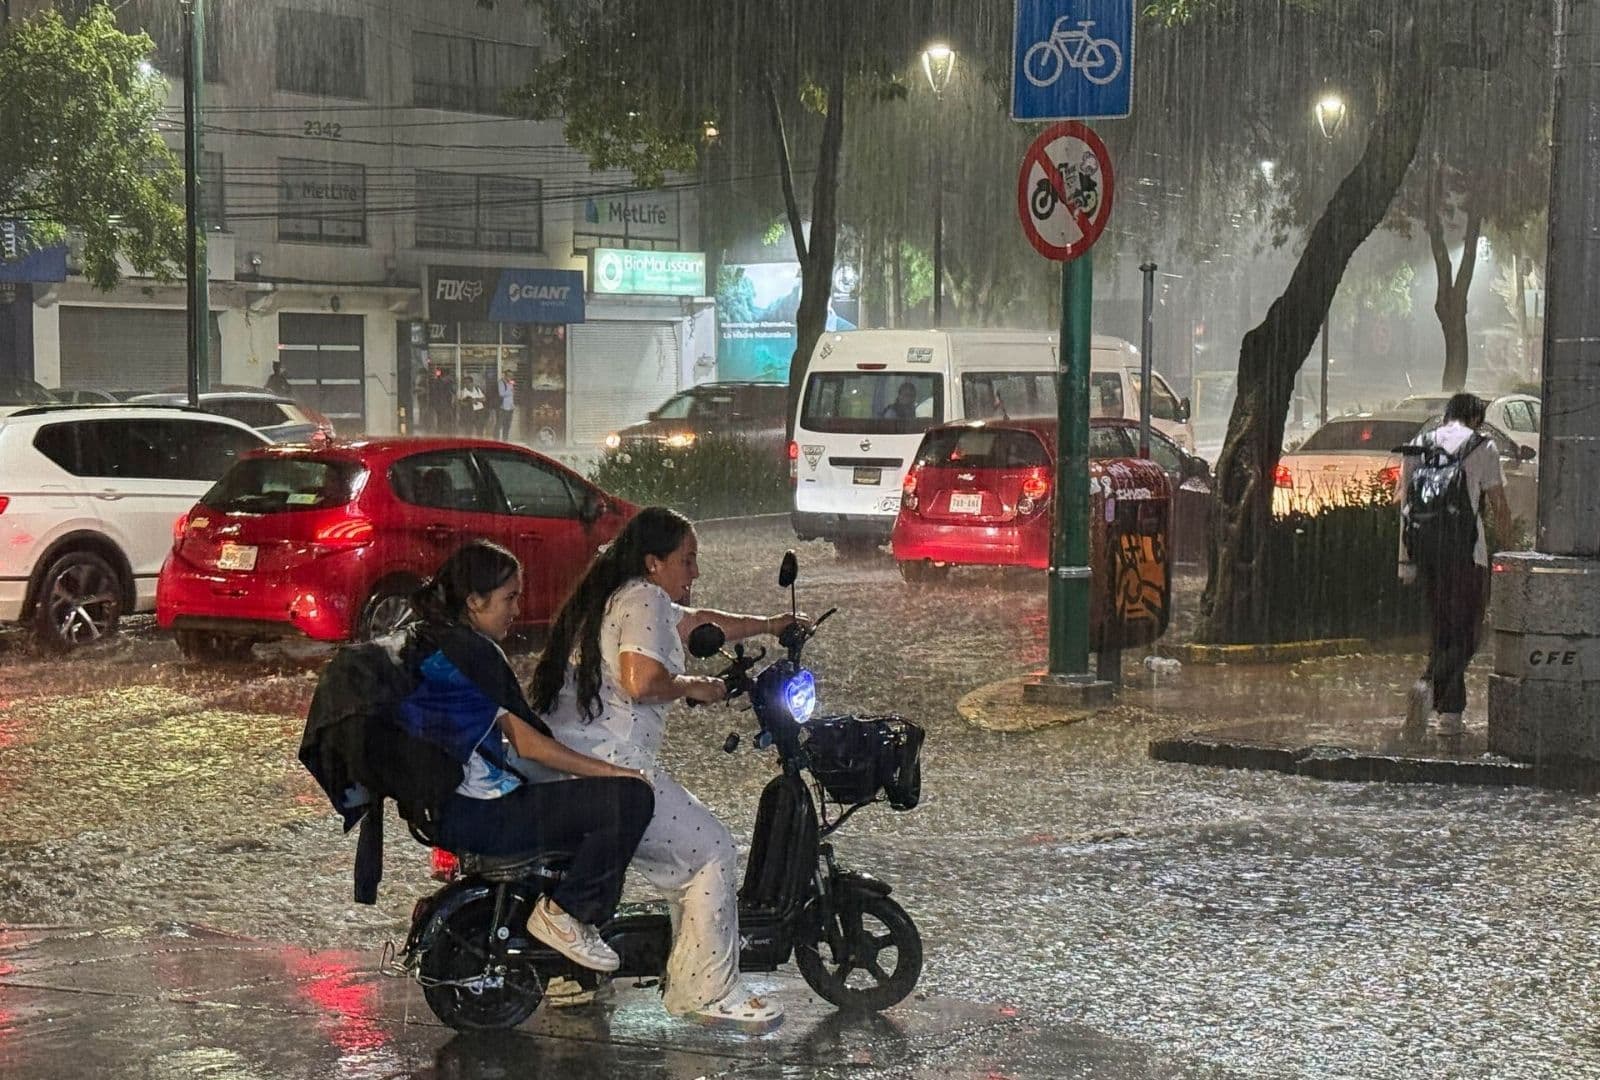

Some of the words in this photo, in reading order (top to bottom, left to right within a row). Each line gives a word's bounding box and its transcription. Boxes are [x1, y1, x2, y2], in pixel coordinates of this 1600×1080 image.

[303, 120, 342, 138] 2342
[302, 181, 357, 201] MetLife
[608, 201, 667, 225] MetLife
[436, 279, 464, 301] FOX
[520, 285, 571, 300] GIANT
[1529, 649, 1577, 666] CFE
